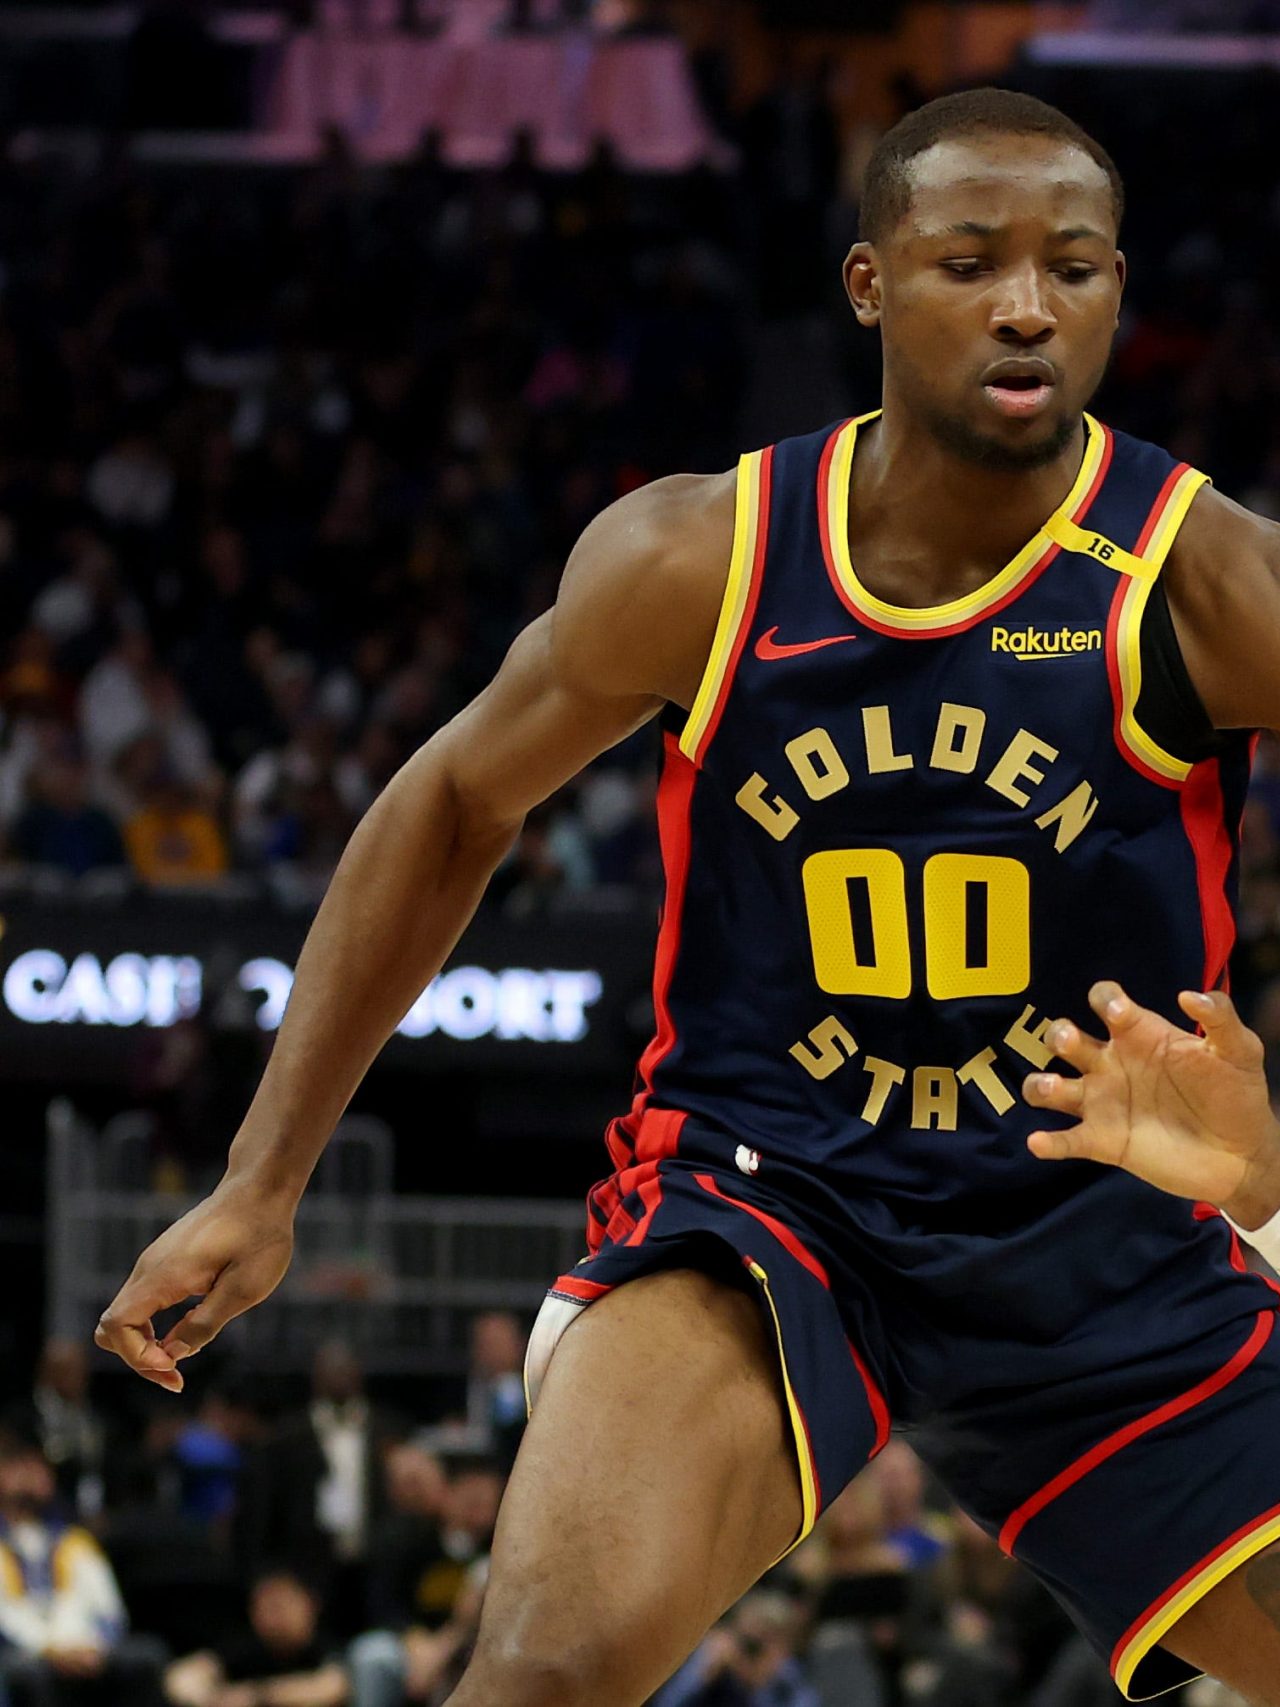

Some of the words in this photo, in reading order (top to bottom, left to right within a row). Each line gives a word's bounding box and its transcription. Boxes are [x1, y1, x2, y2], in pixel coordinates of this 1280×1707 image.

[1087, 537, 1116, 561] 16
[991, 627, 1102, 654] Rakuten
[735, 702, 1100, 854] GOLDEN
[802, 848, 1031, 1001] 00
[788, 1003, 1058, 1132] STATE
